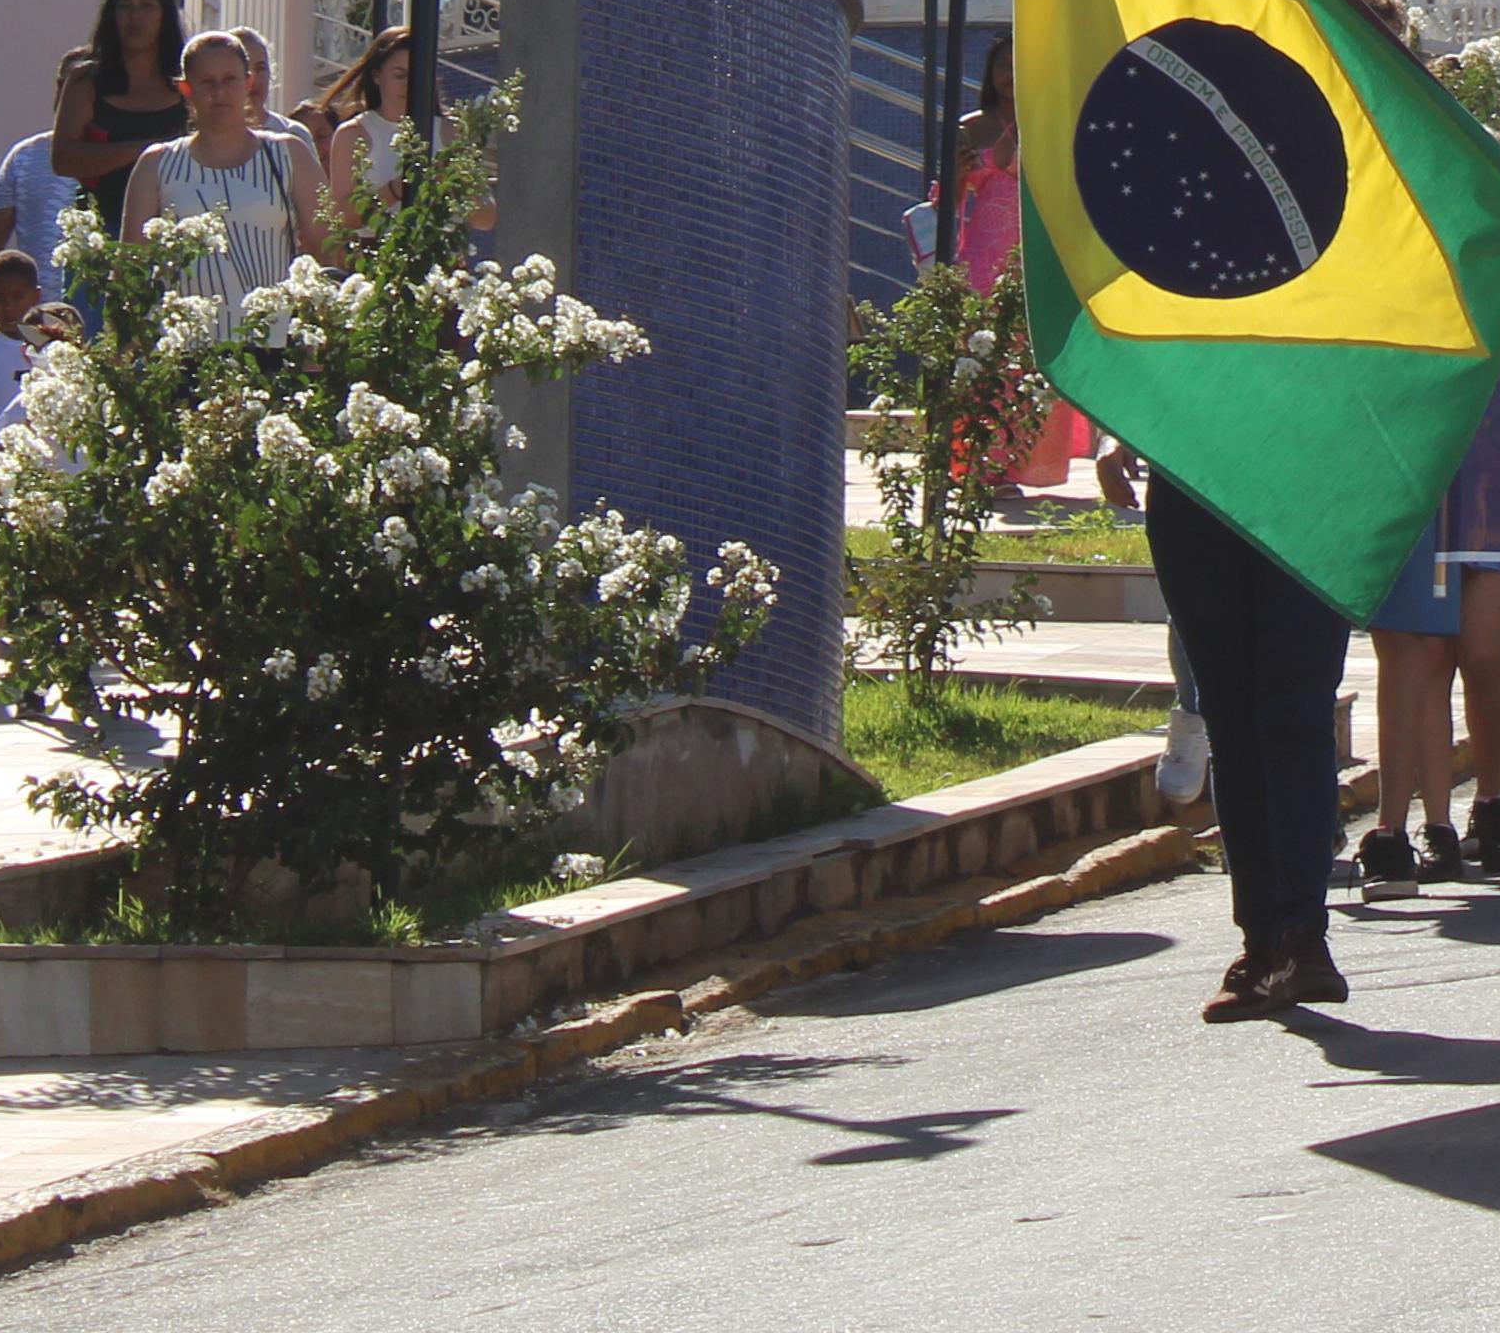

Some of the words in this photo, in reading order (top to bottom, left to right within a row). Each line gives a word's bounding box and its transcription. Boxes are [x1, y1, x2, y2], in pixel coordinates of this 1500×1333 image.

[1147, 43, 1216, 102] ORDEM
[1215, 104, 1229, 122] E
[1230, 123, 1311, 251] PROGRESSO
